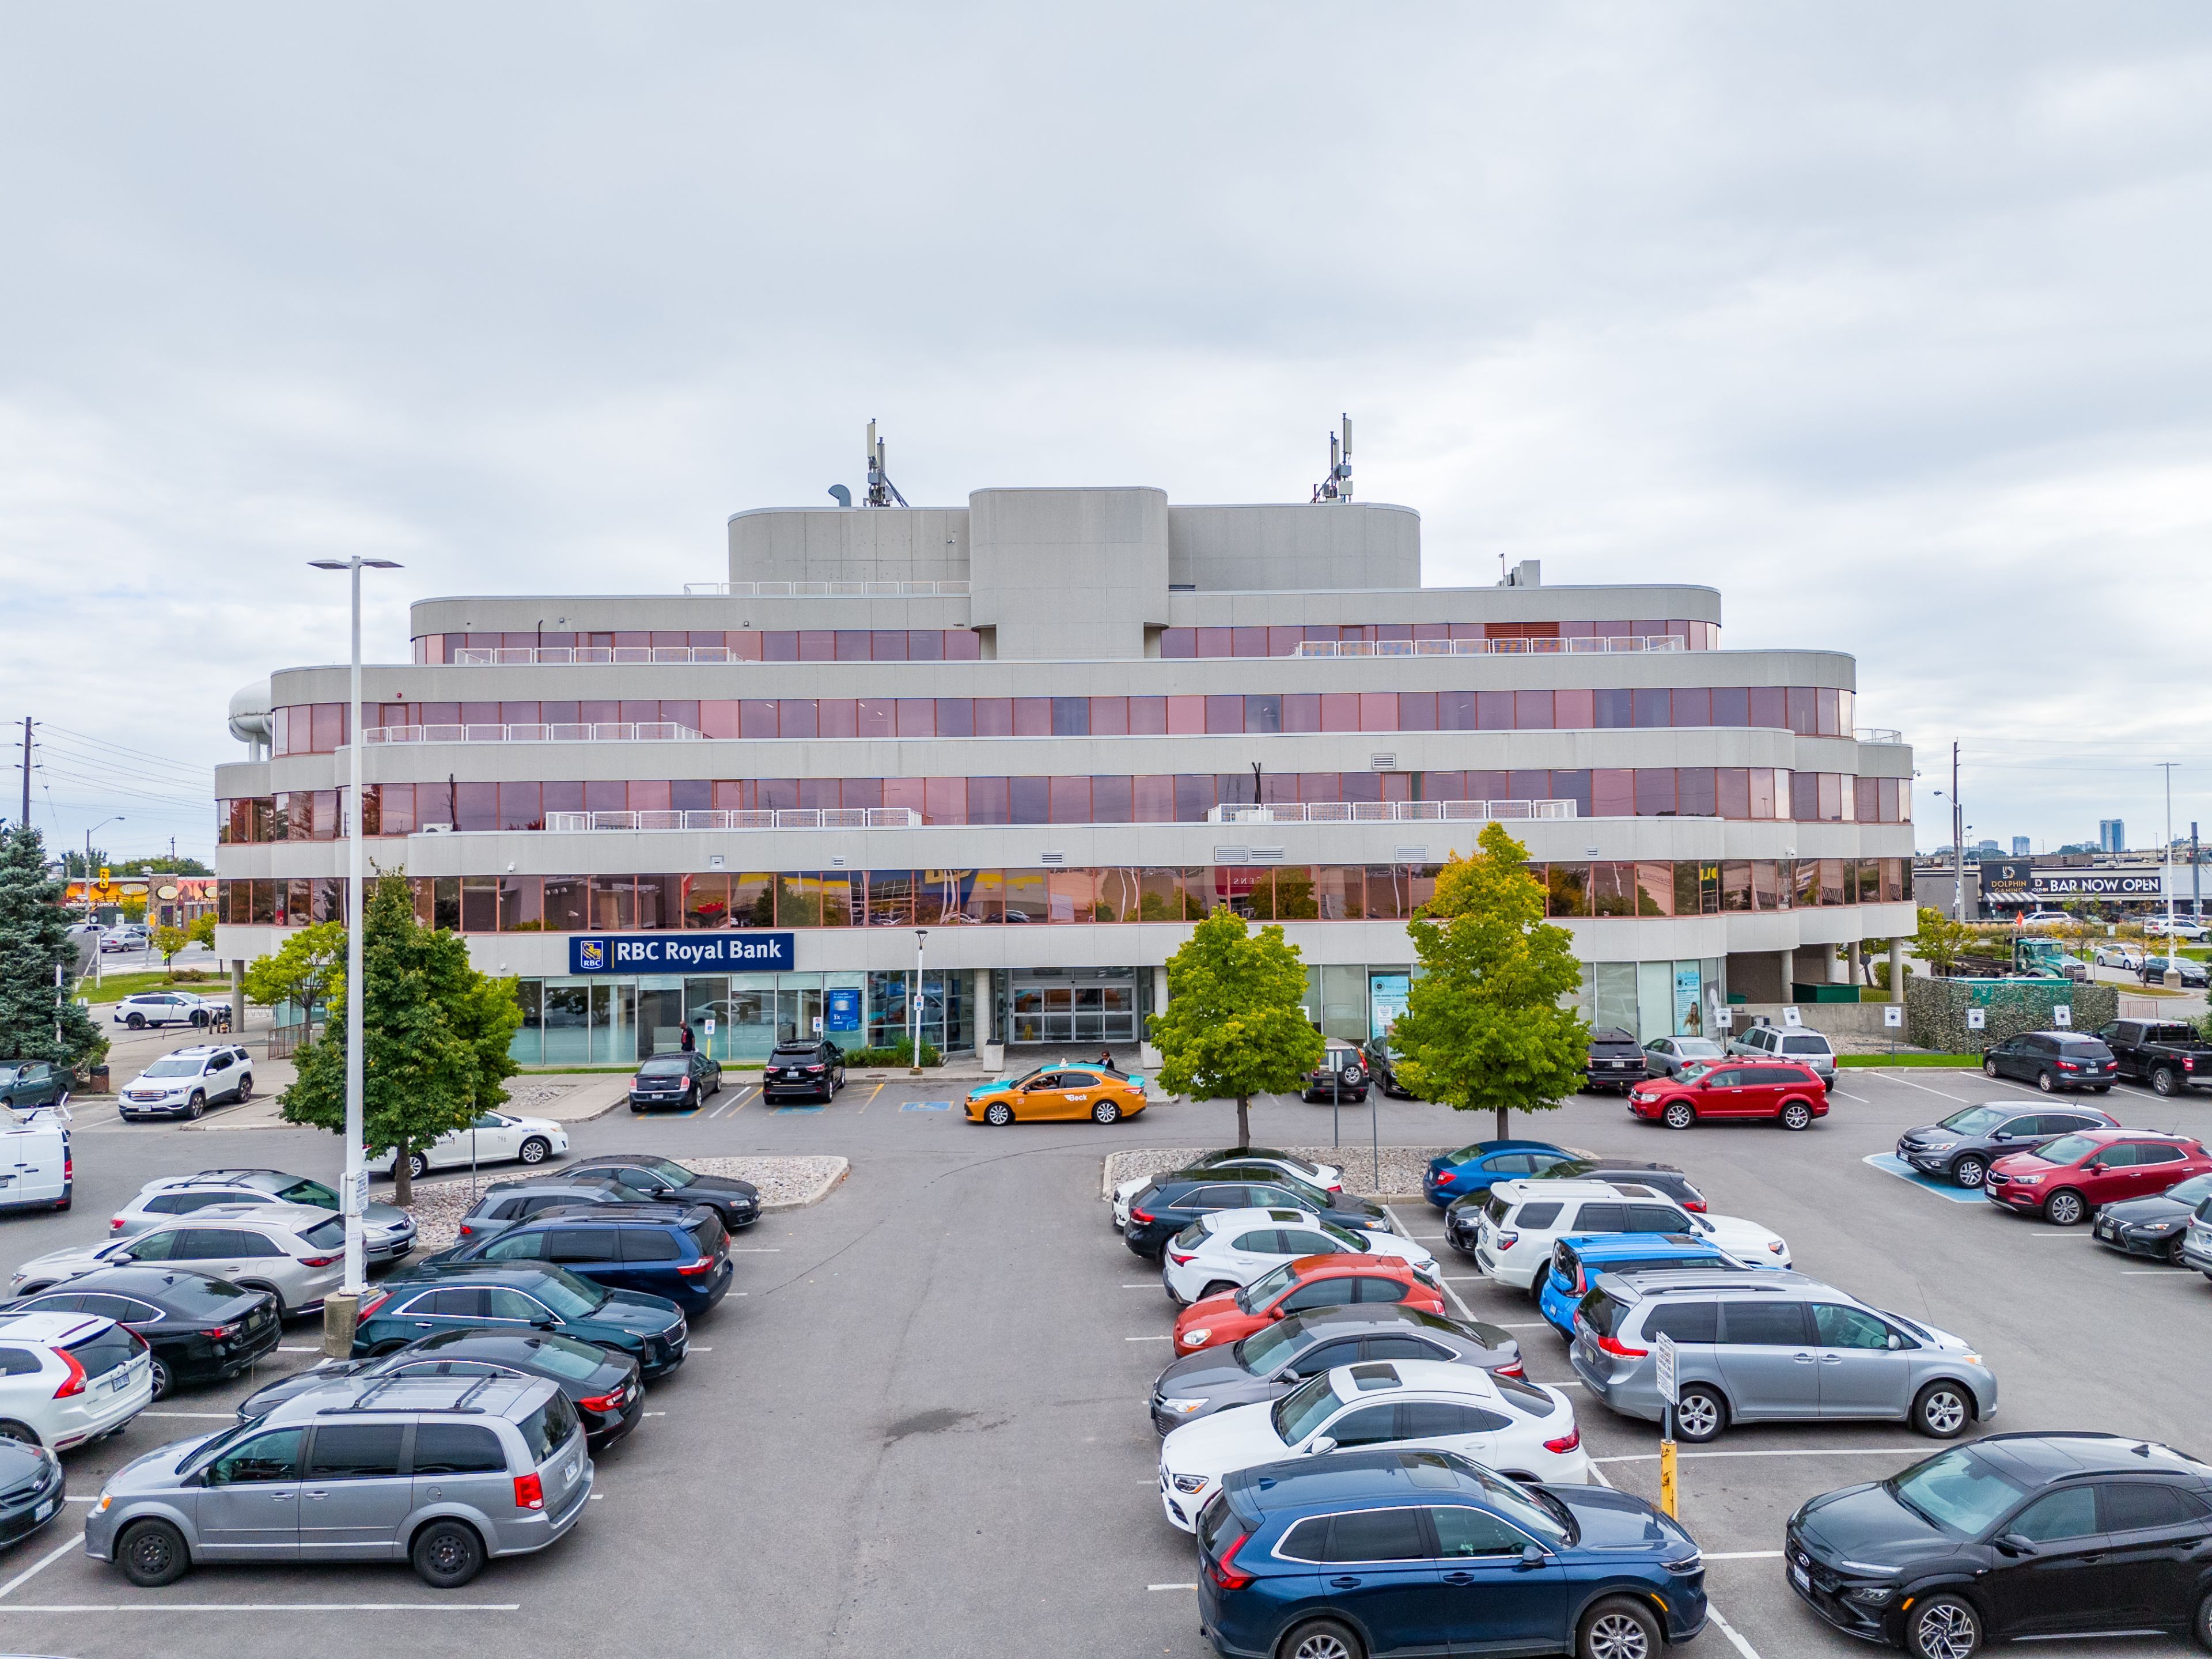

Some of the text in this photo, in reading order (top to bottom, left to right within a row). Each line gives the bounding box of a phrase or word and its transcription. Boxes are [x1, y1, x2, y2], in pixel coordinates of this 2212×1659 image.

[2050, 878, 2158, 892] BAR NOW OPEN
[618, 939, 782, 964] RBC Royal Bank
